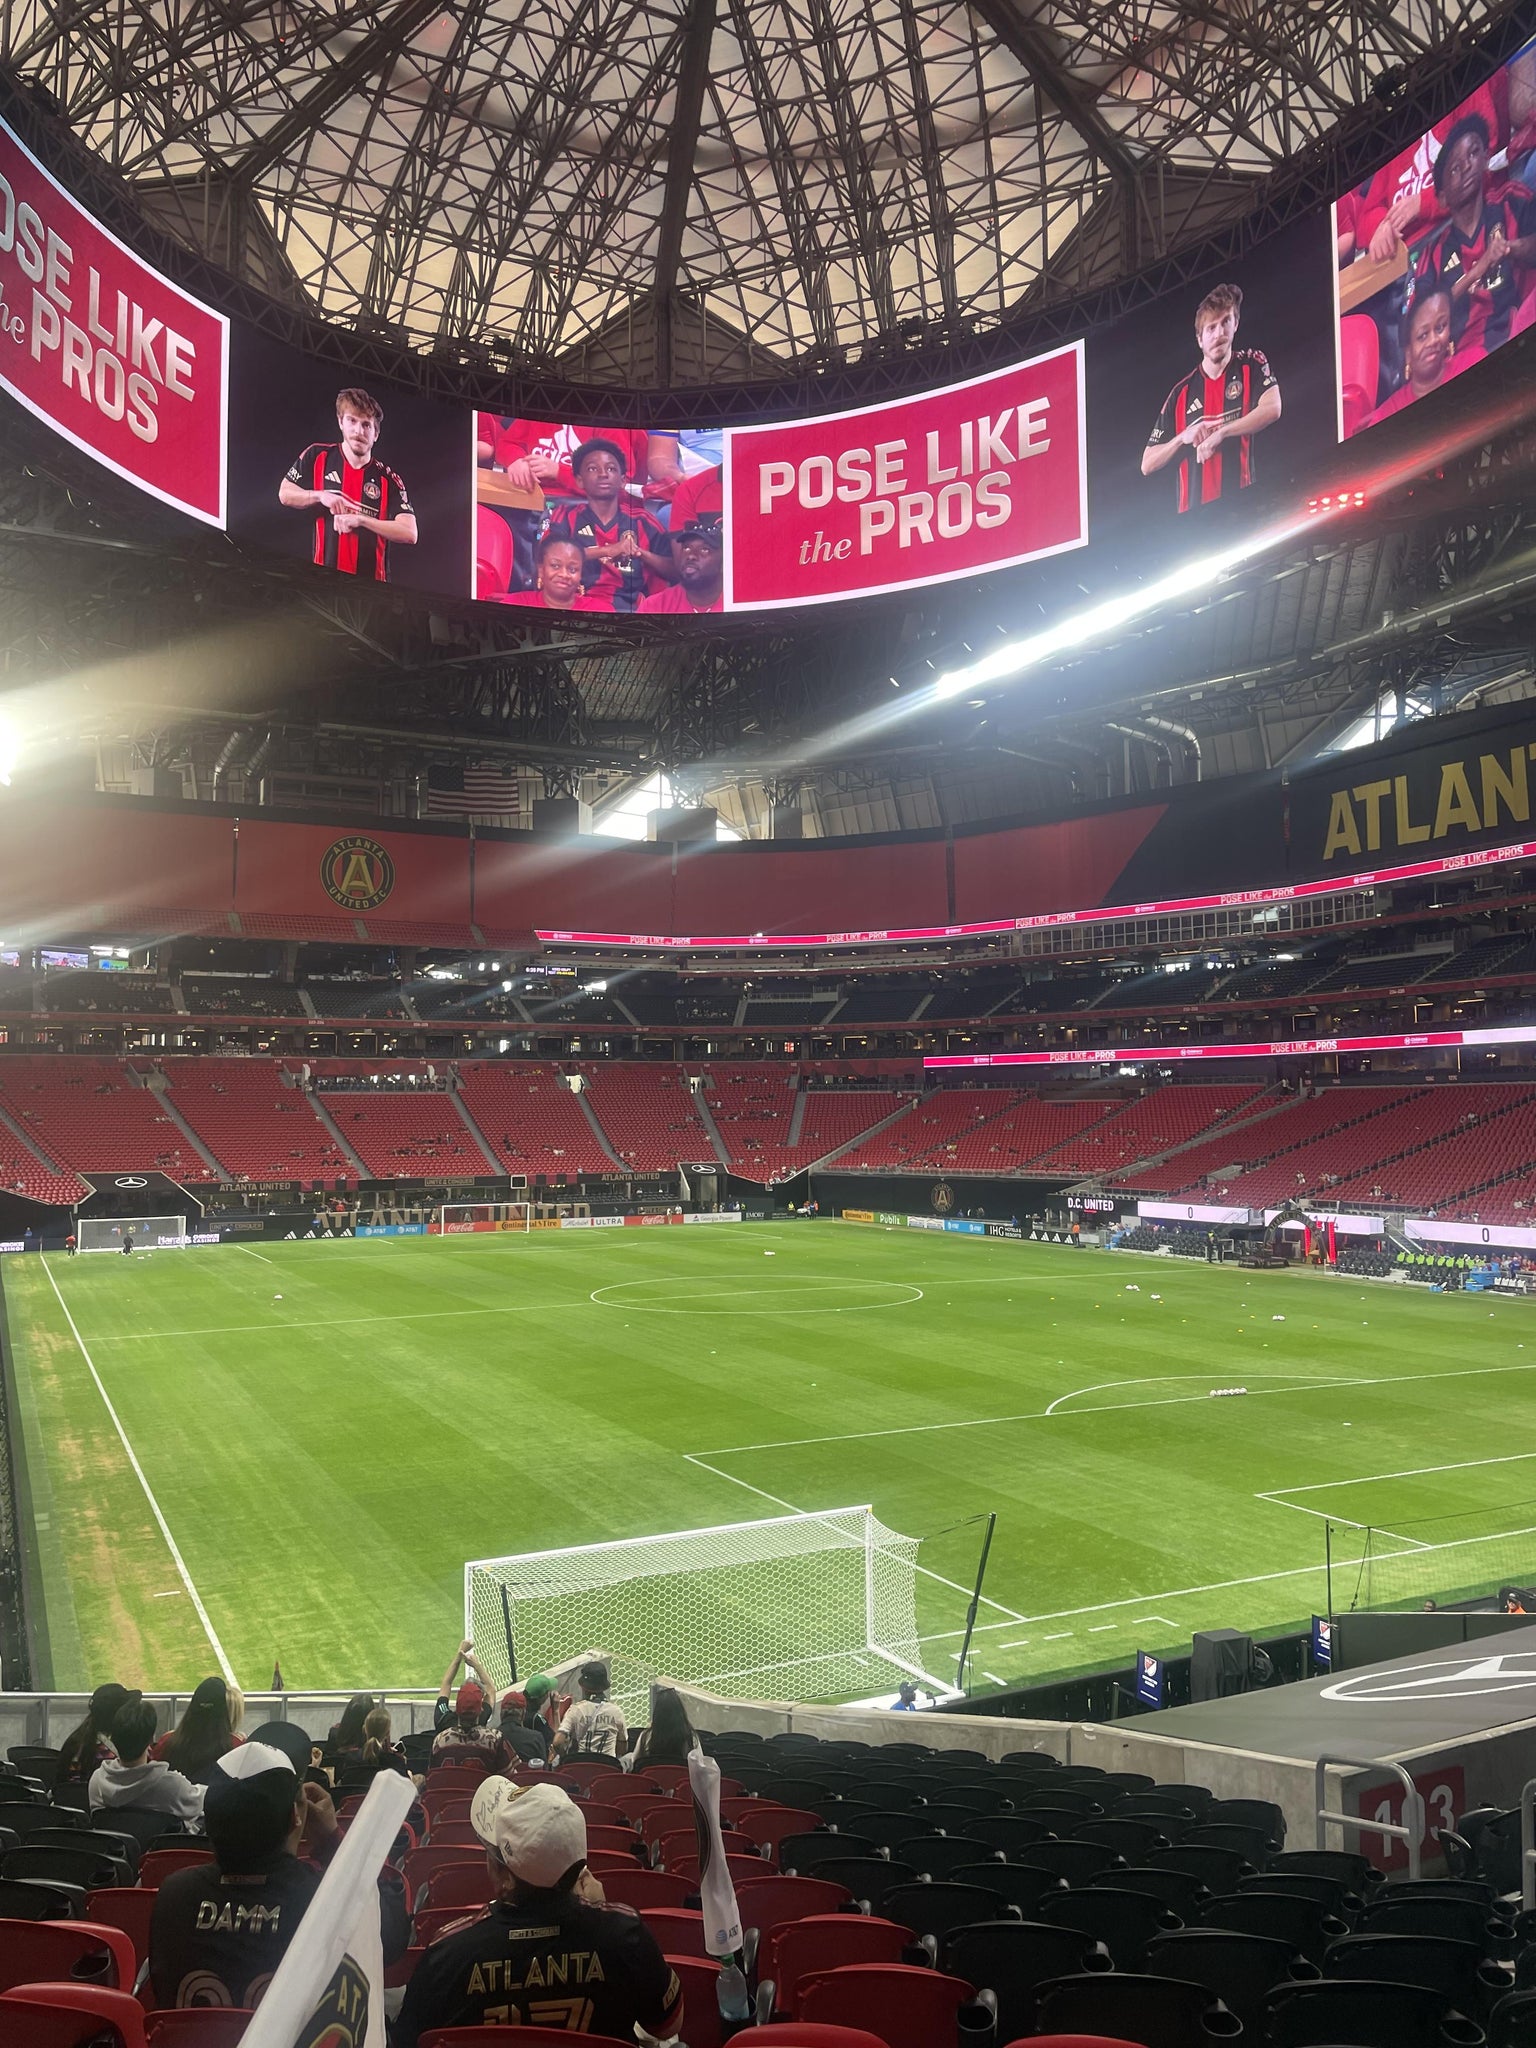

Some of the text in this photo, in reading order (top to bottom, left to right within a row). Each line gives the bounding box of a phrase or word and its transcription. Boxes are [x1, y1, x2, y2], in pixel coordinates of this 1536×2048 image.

[88, 265, 196, 401] LIKE
[30, 287, 159, 444] PROS
[759, 397, 1051, 515] POSE LIKE
[799, 471, 1012, 565] the PROS
[1323, 743, 1536, 860] ATLAN
[333, 839, 384, 858] ATLANTA
[1442, 857, 1466, 870] POSE
[1467, 852, 1488, 866] LIKE
[1498, 846, 1524, 860] PROS
[341, 855, 375, 895] A
[329, 886, 386, 908] UNITED FC
[1221, 894, 1242, 904] POSE
[1244, 891, 1262, 902] LIKE
[1272, 887, 1295, 899] PROS
[1050, 1052, 1069, 1062] POSE
[1070, 1051, 1087, 1061] LIKE
[1095, 1050, 1115, 1060] PROS
[1271, 1043, 1290, 1053] POSE
[1291, 1042, 1308, 1052] LIKE
[1316, 1040, 1337, 1051] PROS
[601, 1172, 660, 1181] ATLANTA UNITED
[219, 1182, 291, 1191] ATLANTA UNITED
[1067, 1197, 1114, 1211] D.C. UNITED
[1188, 1206, 1193, 1218] 0
[595, 1217, 622, 1225] ULTRA
[989, 1225, 1004, 1237] IHG
[1482, 1227, 1489, 1242] 0
[196, 1900, 281, 1933] DAMM
[466, 1950, 605, 1996] ATLANTA
